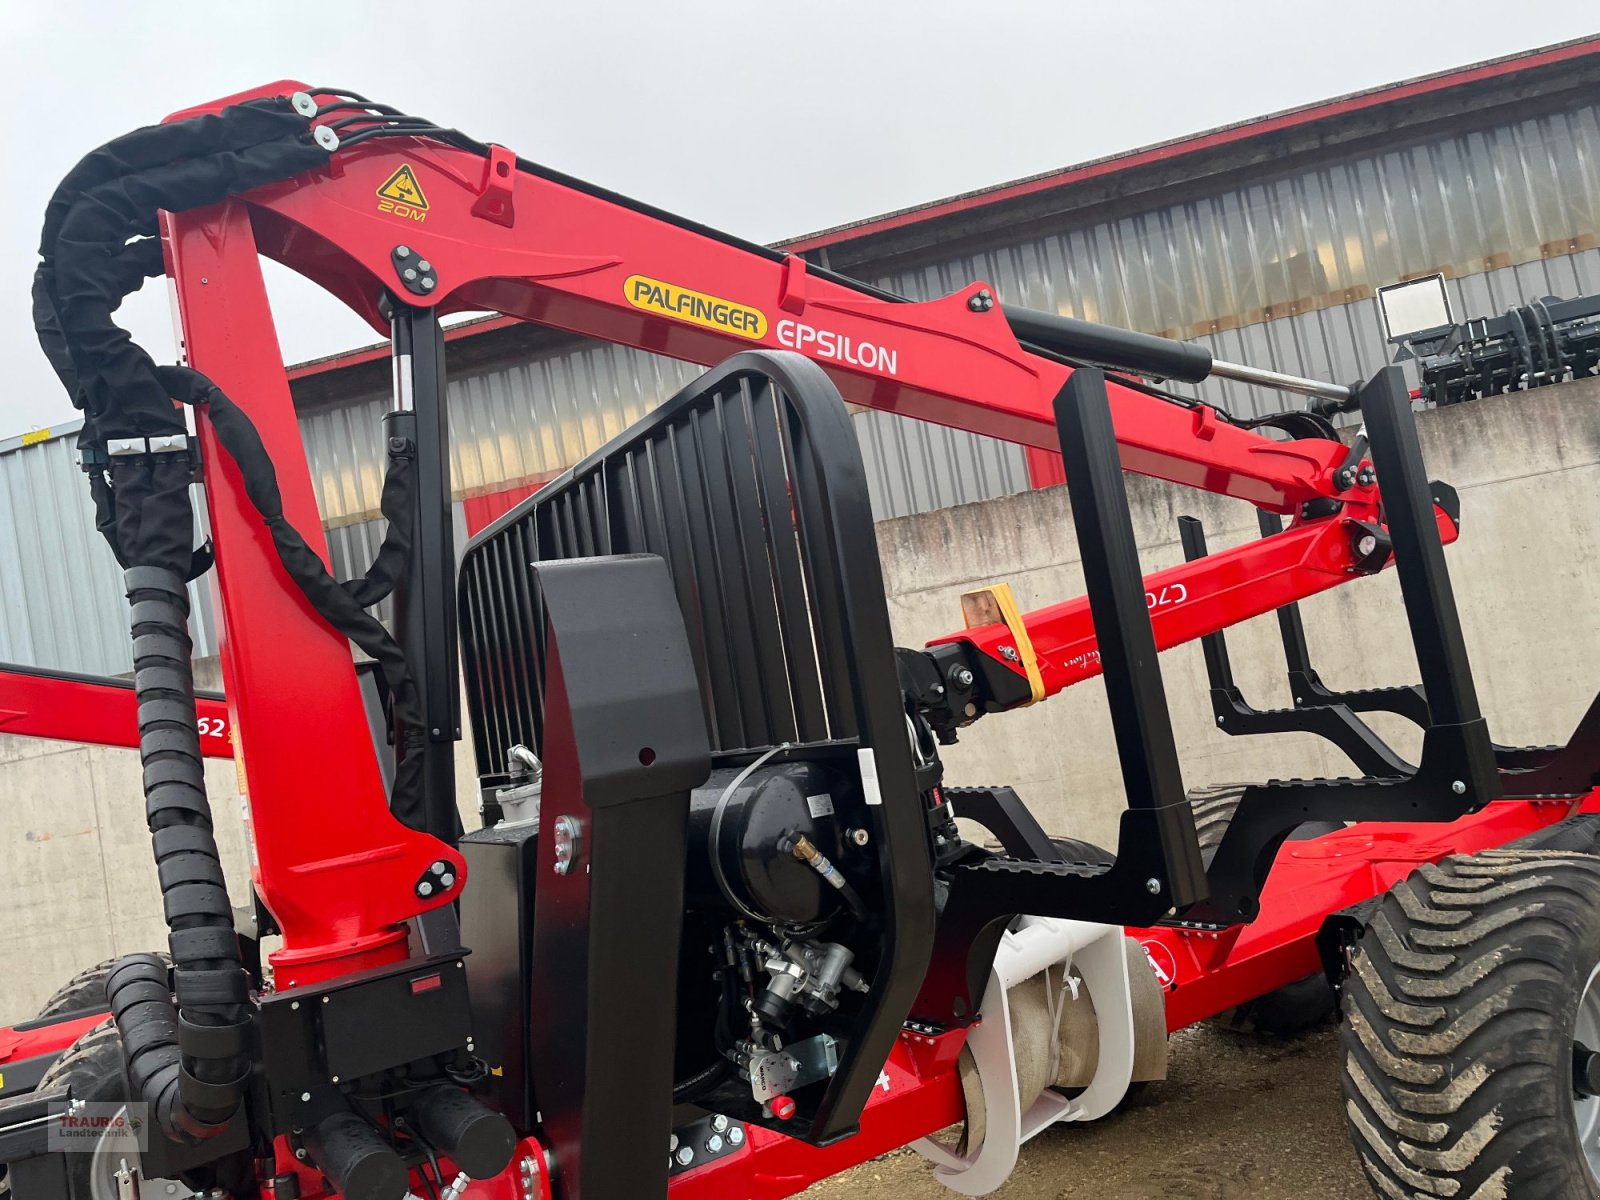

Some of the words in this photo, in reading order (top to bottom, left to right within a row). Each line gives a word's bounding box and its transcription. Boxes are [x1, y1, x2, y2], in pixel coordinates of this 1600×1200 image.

[377, 200, 426, 222] 20M
[634, 280, 759, 334] PALFINGER
[776, 319, 897, 374] EPSILON
